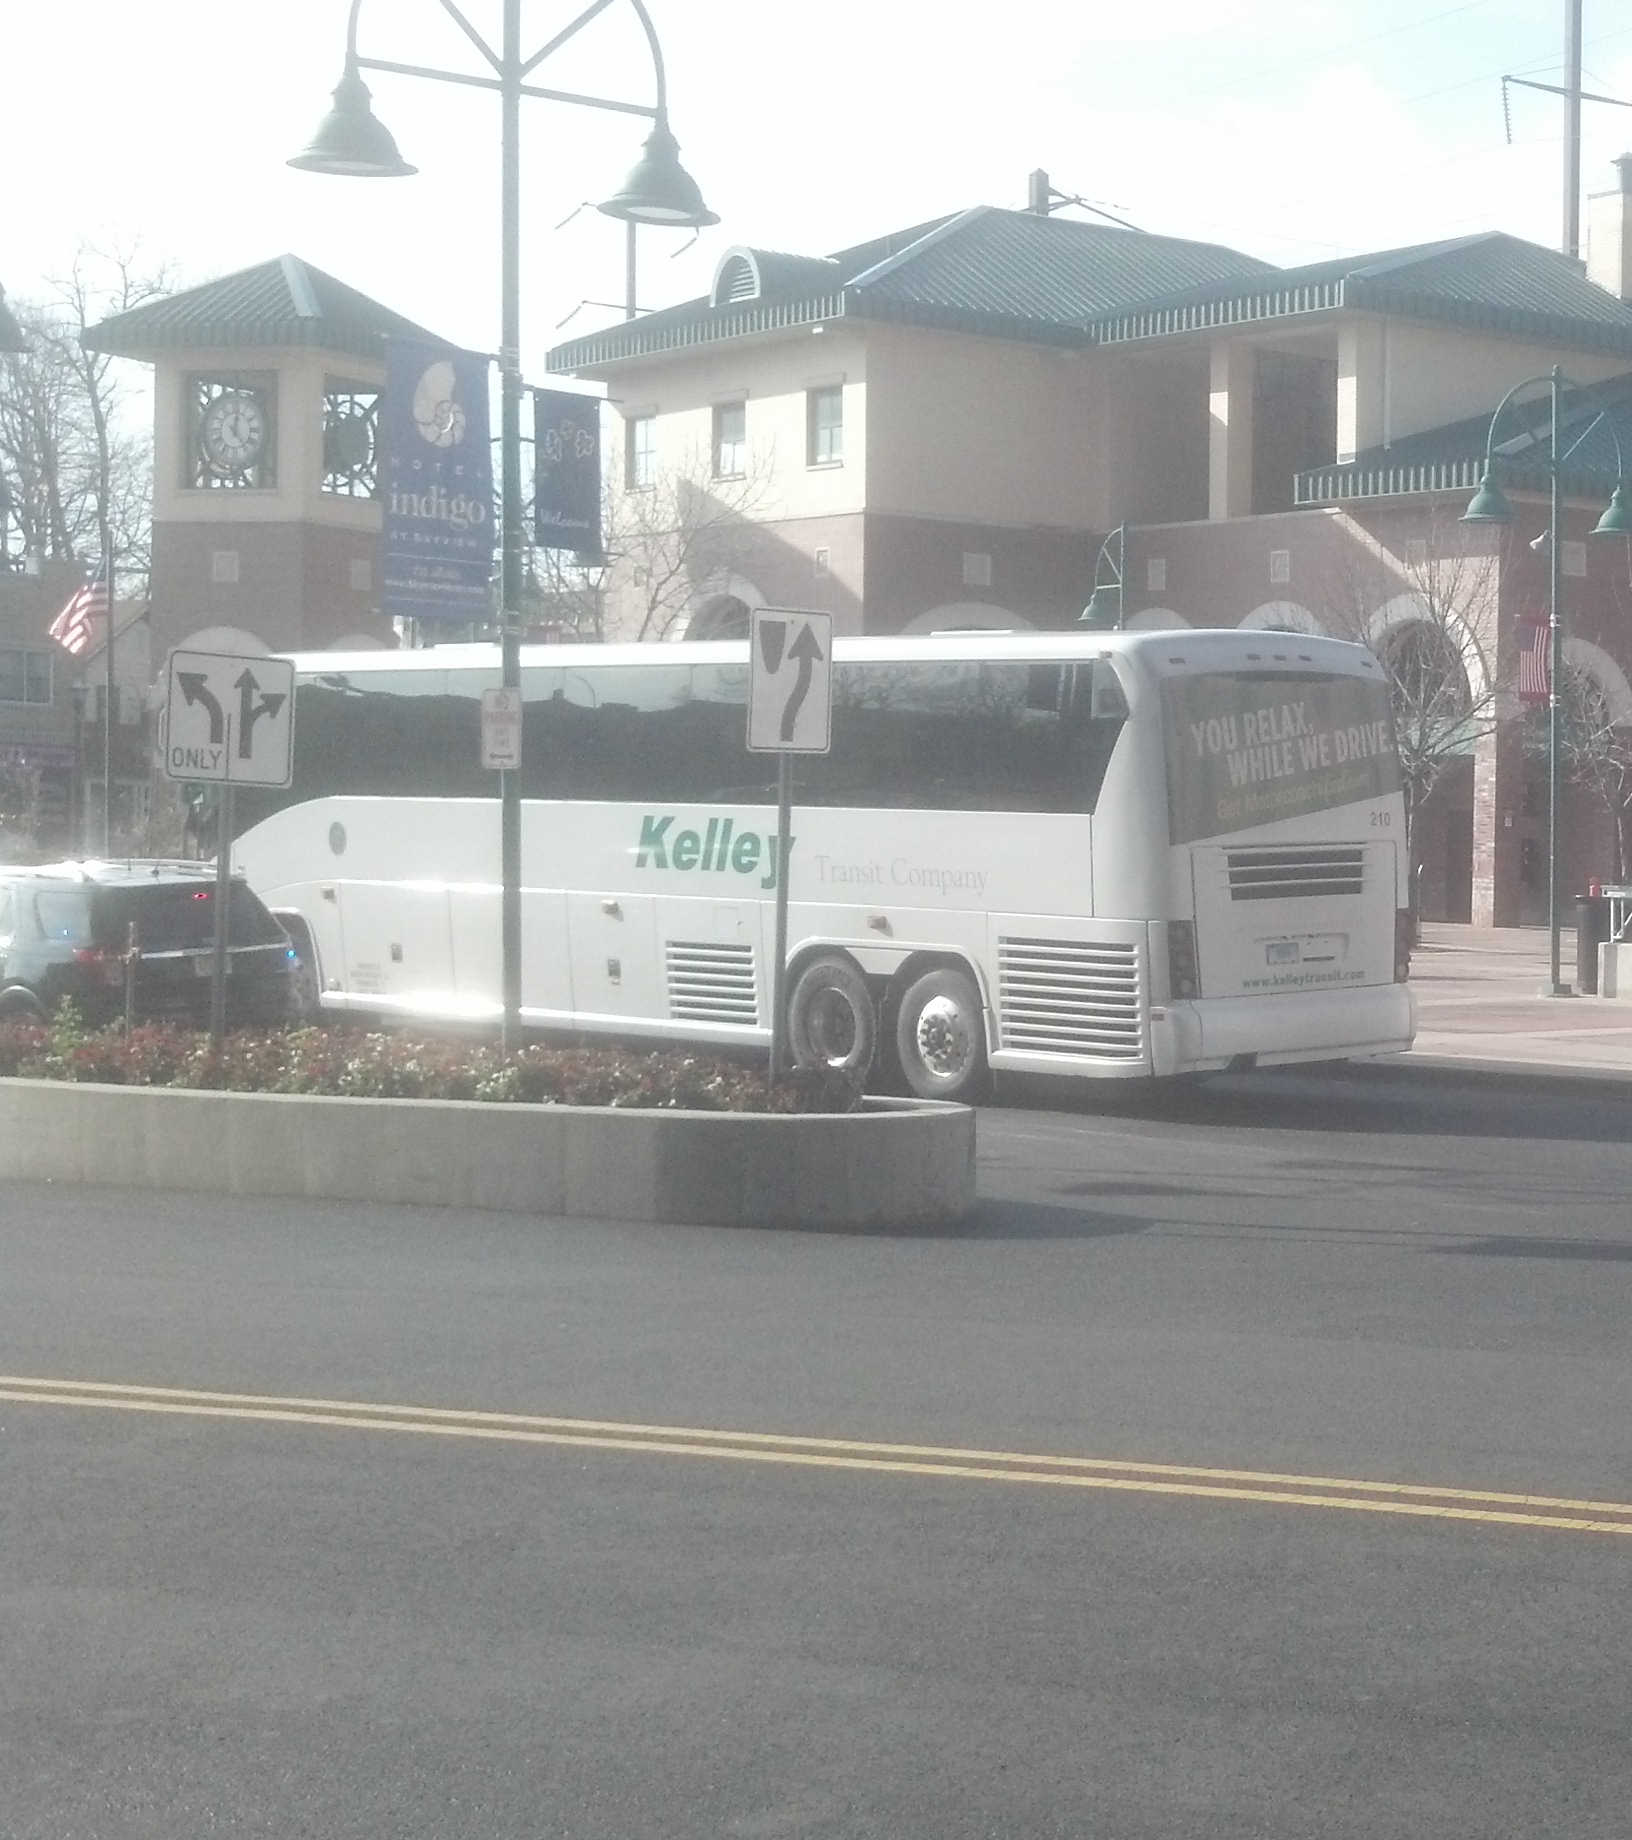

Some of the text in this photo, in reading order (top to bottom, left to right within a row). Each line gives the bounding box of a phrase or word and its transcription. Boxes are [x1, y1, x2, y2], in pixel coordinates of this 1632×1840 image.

[390, 483, 486, 531] indigo
[1190, 701, 1314, 757] YOU RELAX,
[172, 747, 222, 770] ONLY
[1227, 741, 1295, 787] WHILE
[1299, 733, 1331, 771] WE
[1217, 799, 1242, 820] Get
[1370, 812, 1391, 826] 210
[635, 815, 796, 890] Kelley
[814, 854, 990, 897] Transit Company
[1242, 968, 1366, 989] www.kelleytransit.com
